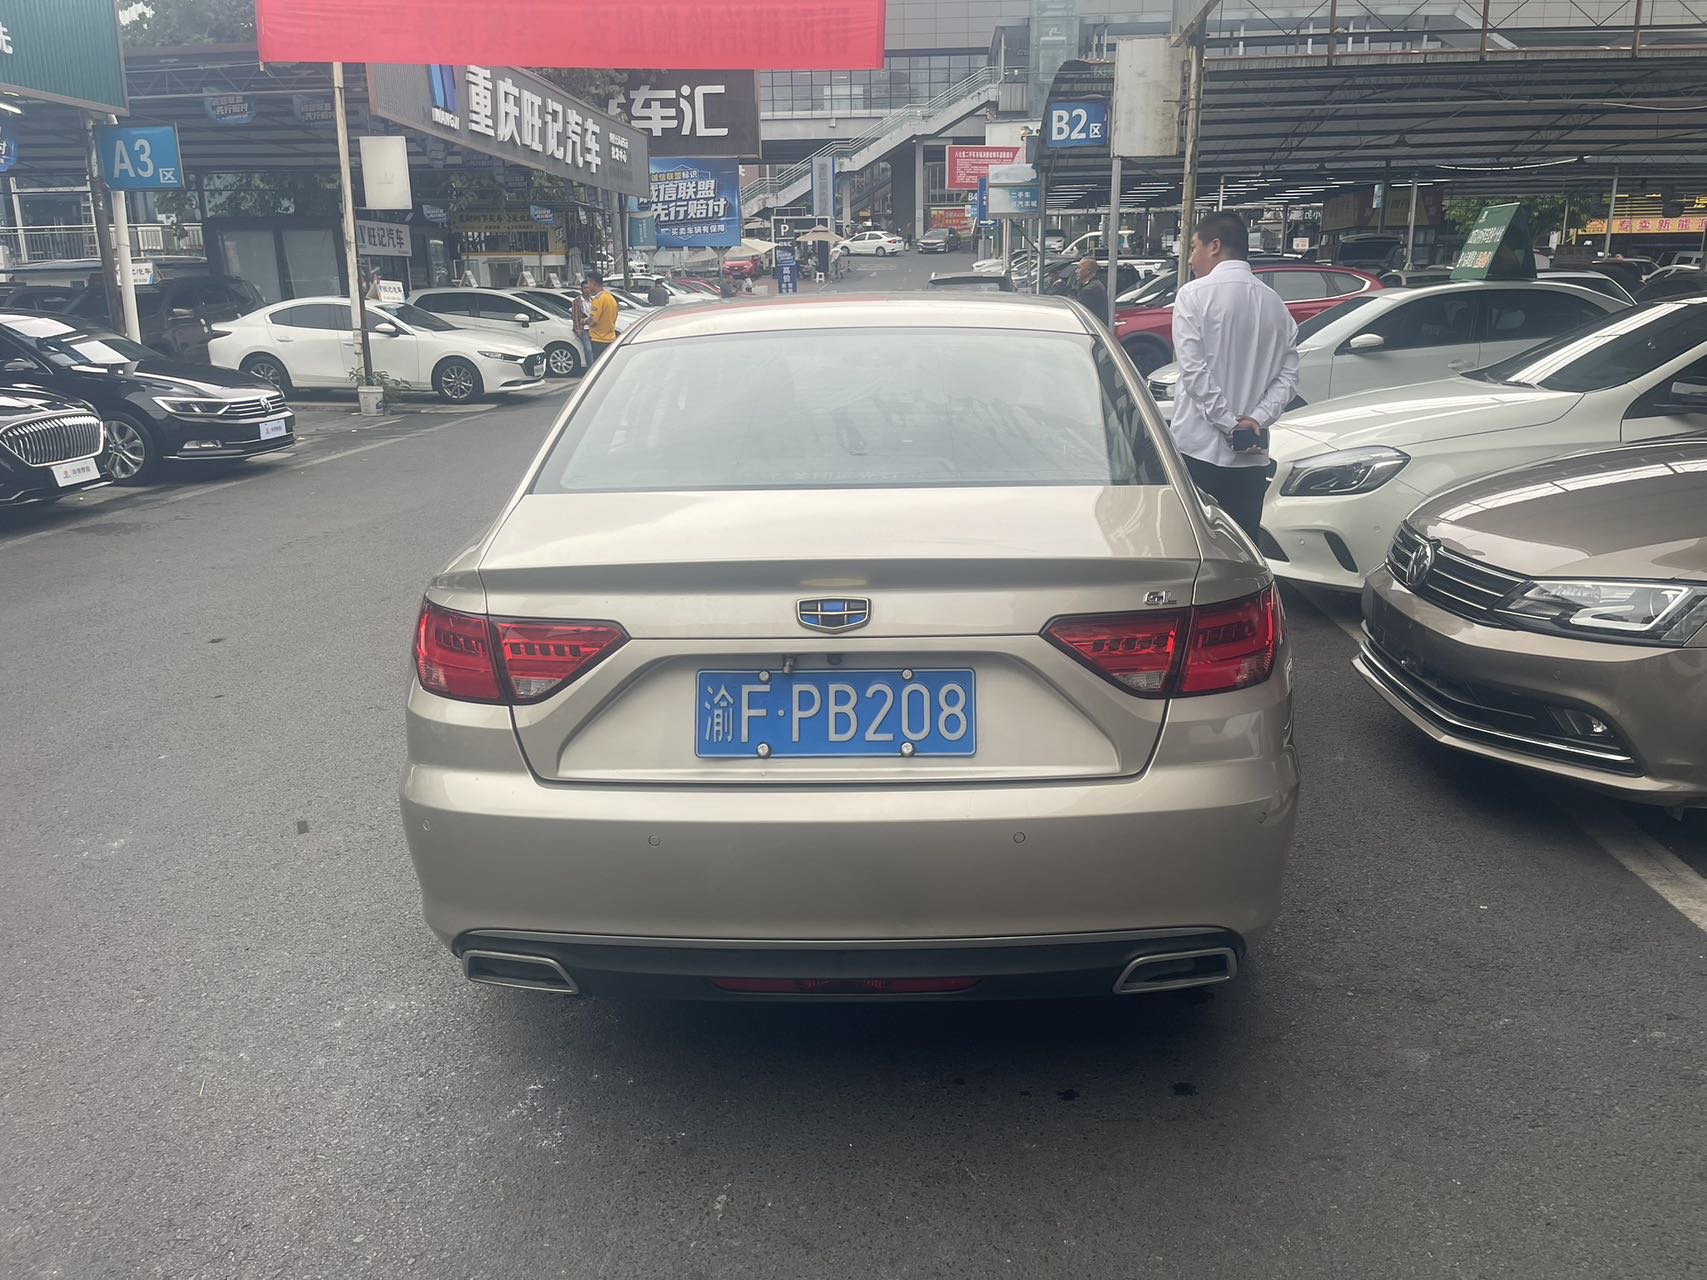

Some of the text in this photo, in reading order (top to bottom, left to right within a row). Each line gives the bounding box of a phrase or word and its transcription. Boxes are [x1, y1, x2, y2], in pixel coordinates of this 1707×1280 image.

[466, 65, 600, 173] 重庆旺记汽车
[651, 198, 727, 221] 先行赔付
[367, 226, 405, 249] 旺记汽车
[780, 224, 789, 236] P
[704, 682, 969, 743] 渝F·PB208
